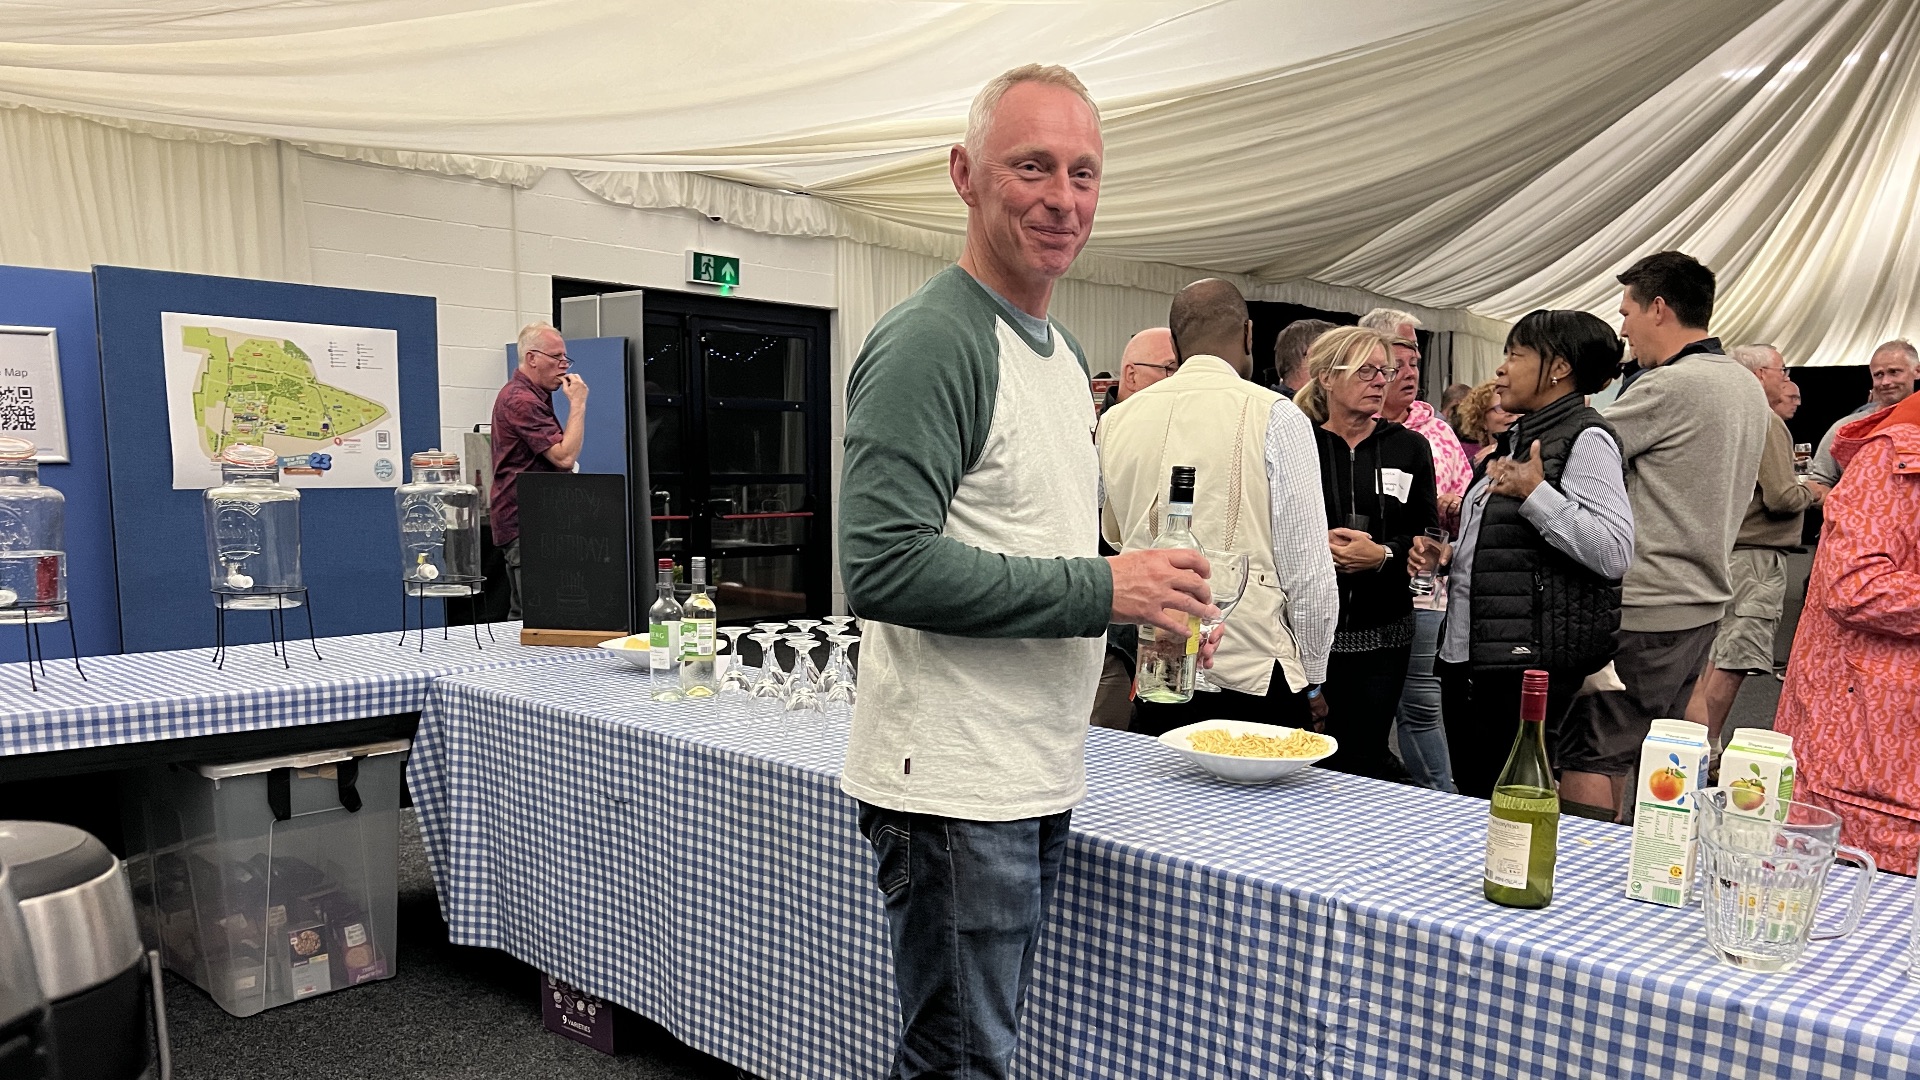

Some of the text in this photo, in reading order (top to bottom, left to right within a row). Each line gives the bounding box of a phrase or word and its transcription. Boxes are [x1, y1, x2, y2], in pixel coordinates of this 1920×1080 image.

[4, 368, 28, 379] Map
[310, 452, 331, 470] 23
[562, 1014, 591, 1033] 9 VARIETIES
